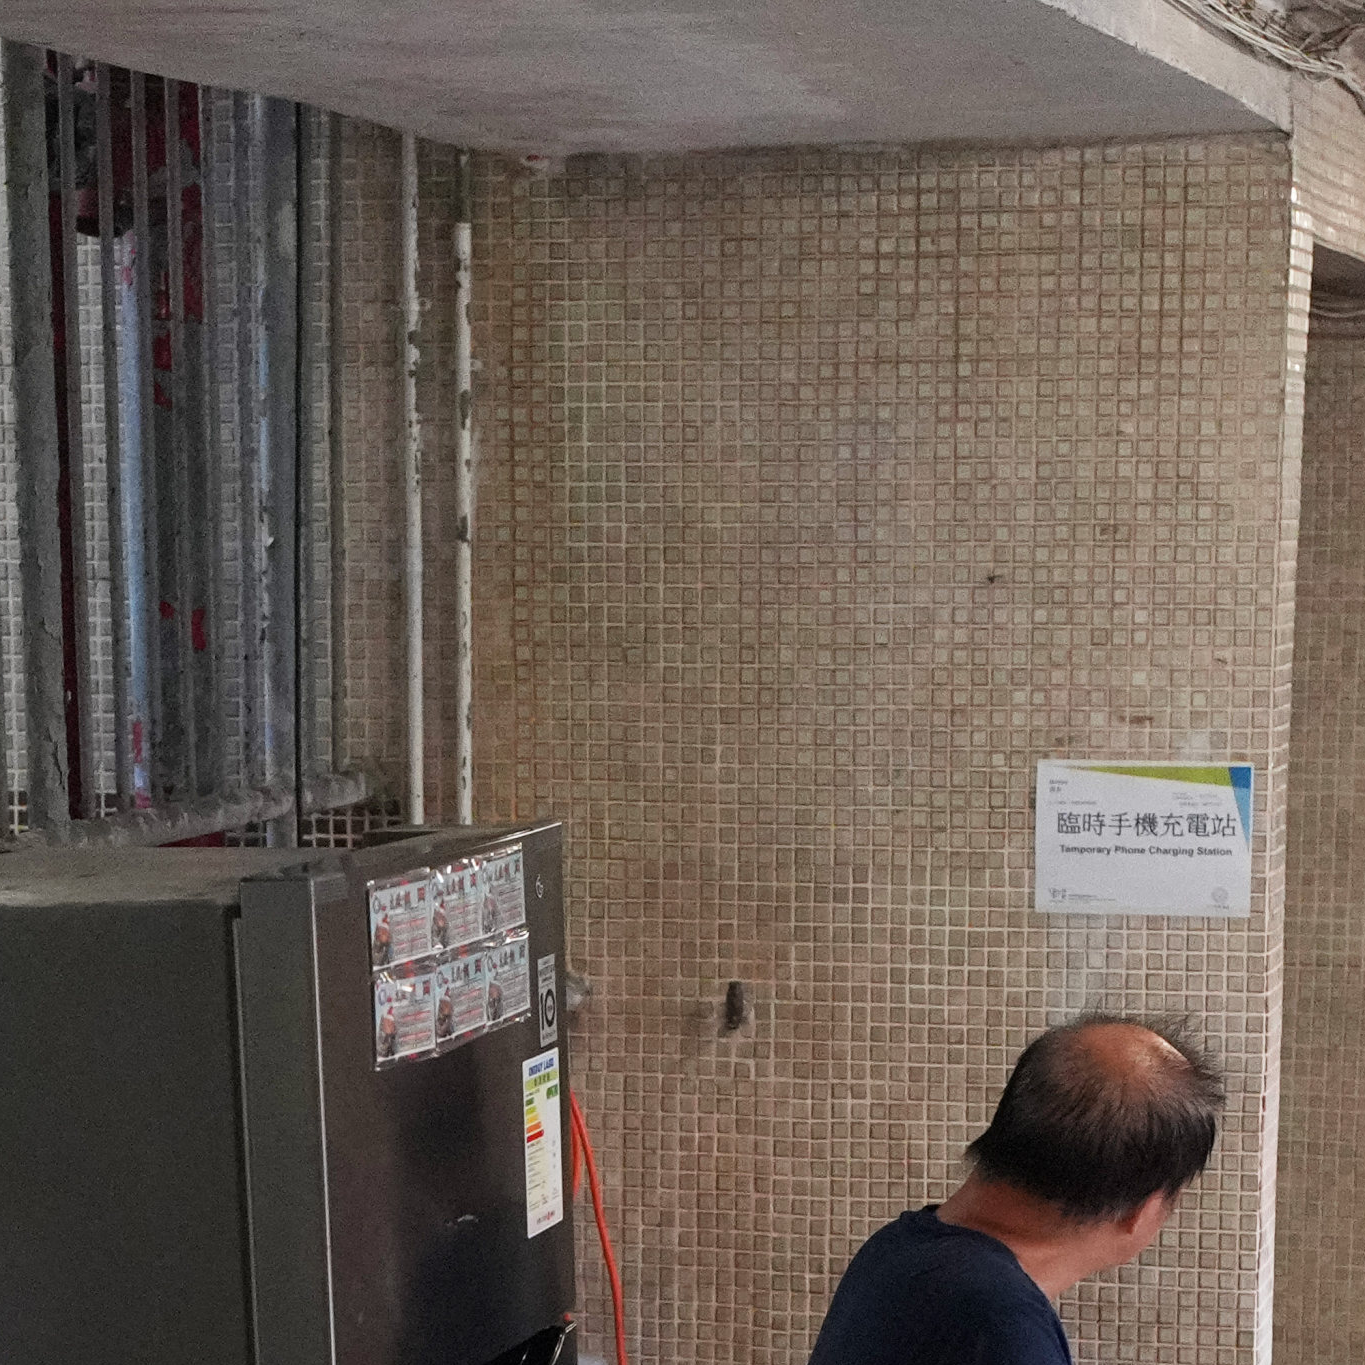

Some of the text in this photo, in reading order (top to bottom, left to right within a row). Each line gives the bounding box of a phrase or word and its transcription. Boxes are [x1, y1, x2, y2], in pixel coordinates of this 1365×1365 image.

[1057, 811, 1237, 837] 臨時手機充電站
[1059, 844, 1233, 857] Temporary Phone Charging Station
